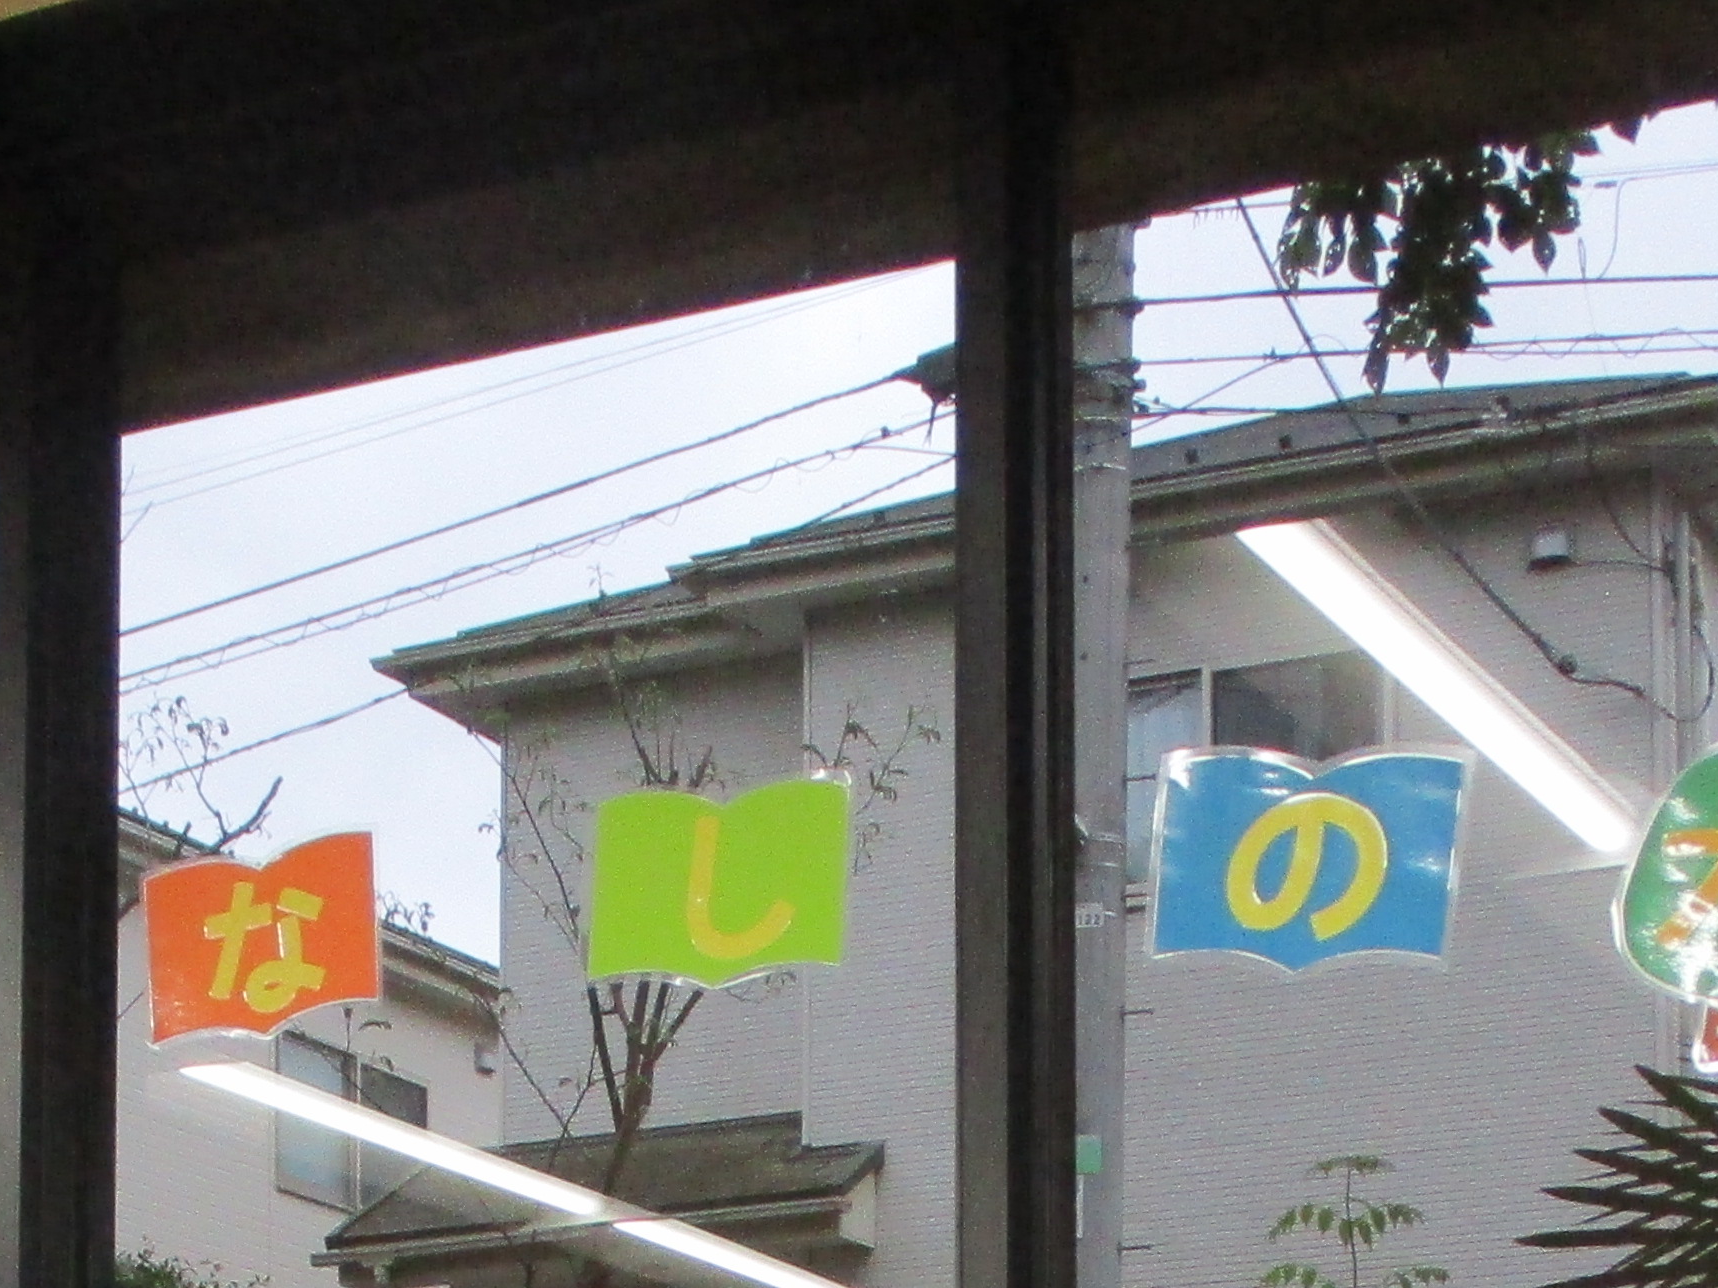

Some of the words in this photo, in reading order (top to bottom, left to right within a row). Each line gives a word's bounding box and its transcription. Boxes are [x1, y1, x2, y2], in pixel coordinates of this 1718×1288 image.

[205, 881, 325, 1013] な
[688, 815, 795, 959] し
[1226, 793, 1388, 941] の
